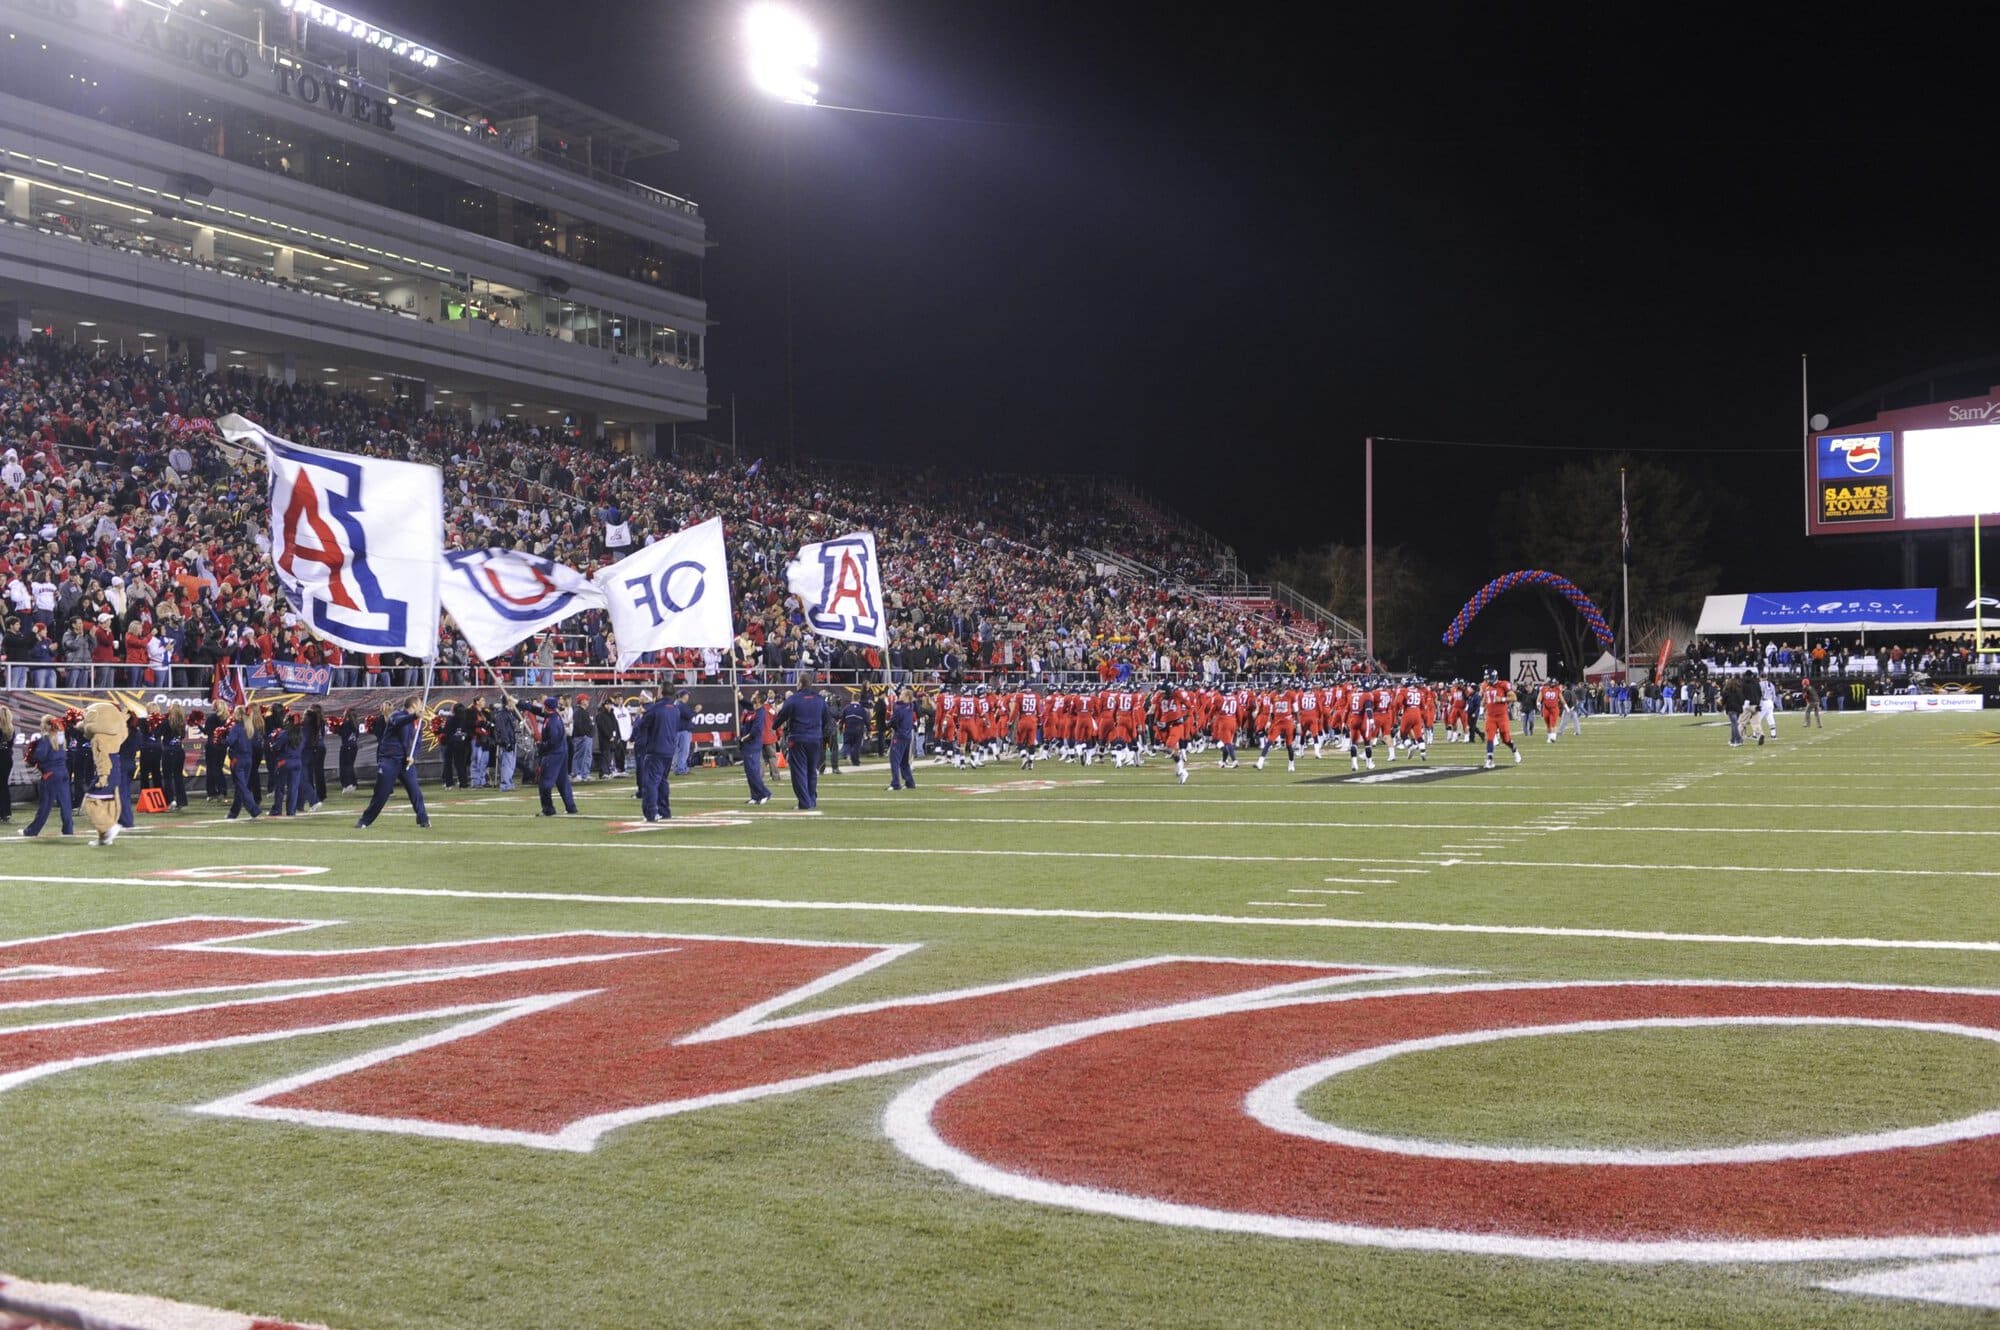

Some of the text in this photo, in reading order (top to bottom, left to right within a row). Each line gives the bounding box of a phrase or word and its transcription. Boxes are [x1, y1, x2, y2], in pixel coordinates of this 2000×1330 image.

[275, 63, 396, 133] TOWER
[1829, 436, 1881, 452] PEPSI
[1825, 485, 1888, 500] SAM'S
[1825, 498, 1888, 511] TOWN
[808, 538, 879, 638] A
[1022, 698, 1036, 711] 59
[1406, 692, 1421, 705] 36
[1221, 700, 1237, 714] 40
[146, 789, 164, 809] 10
